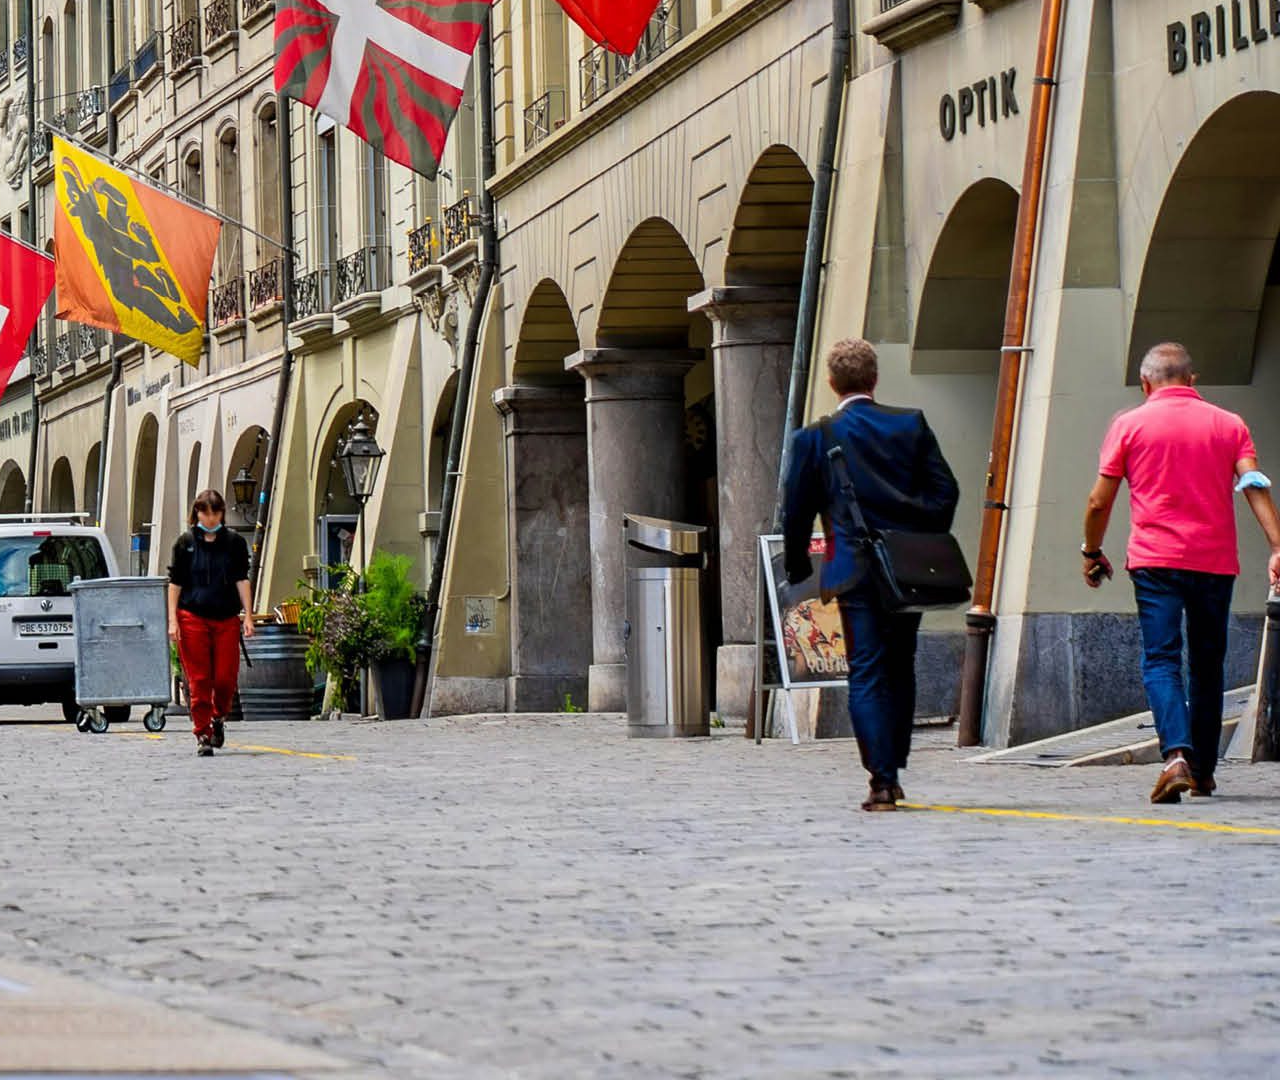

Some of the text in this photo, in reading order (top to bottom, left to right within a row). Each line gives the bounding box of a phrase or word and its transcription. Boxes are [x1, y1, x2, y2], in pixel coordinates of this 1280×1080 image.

[939, 67, 1020, 142] OPTIK
[25, 623, 69, 633] BE 537075
